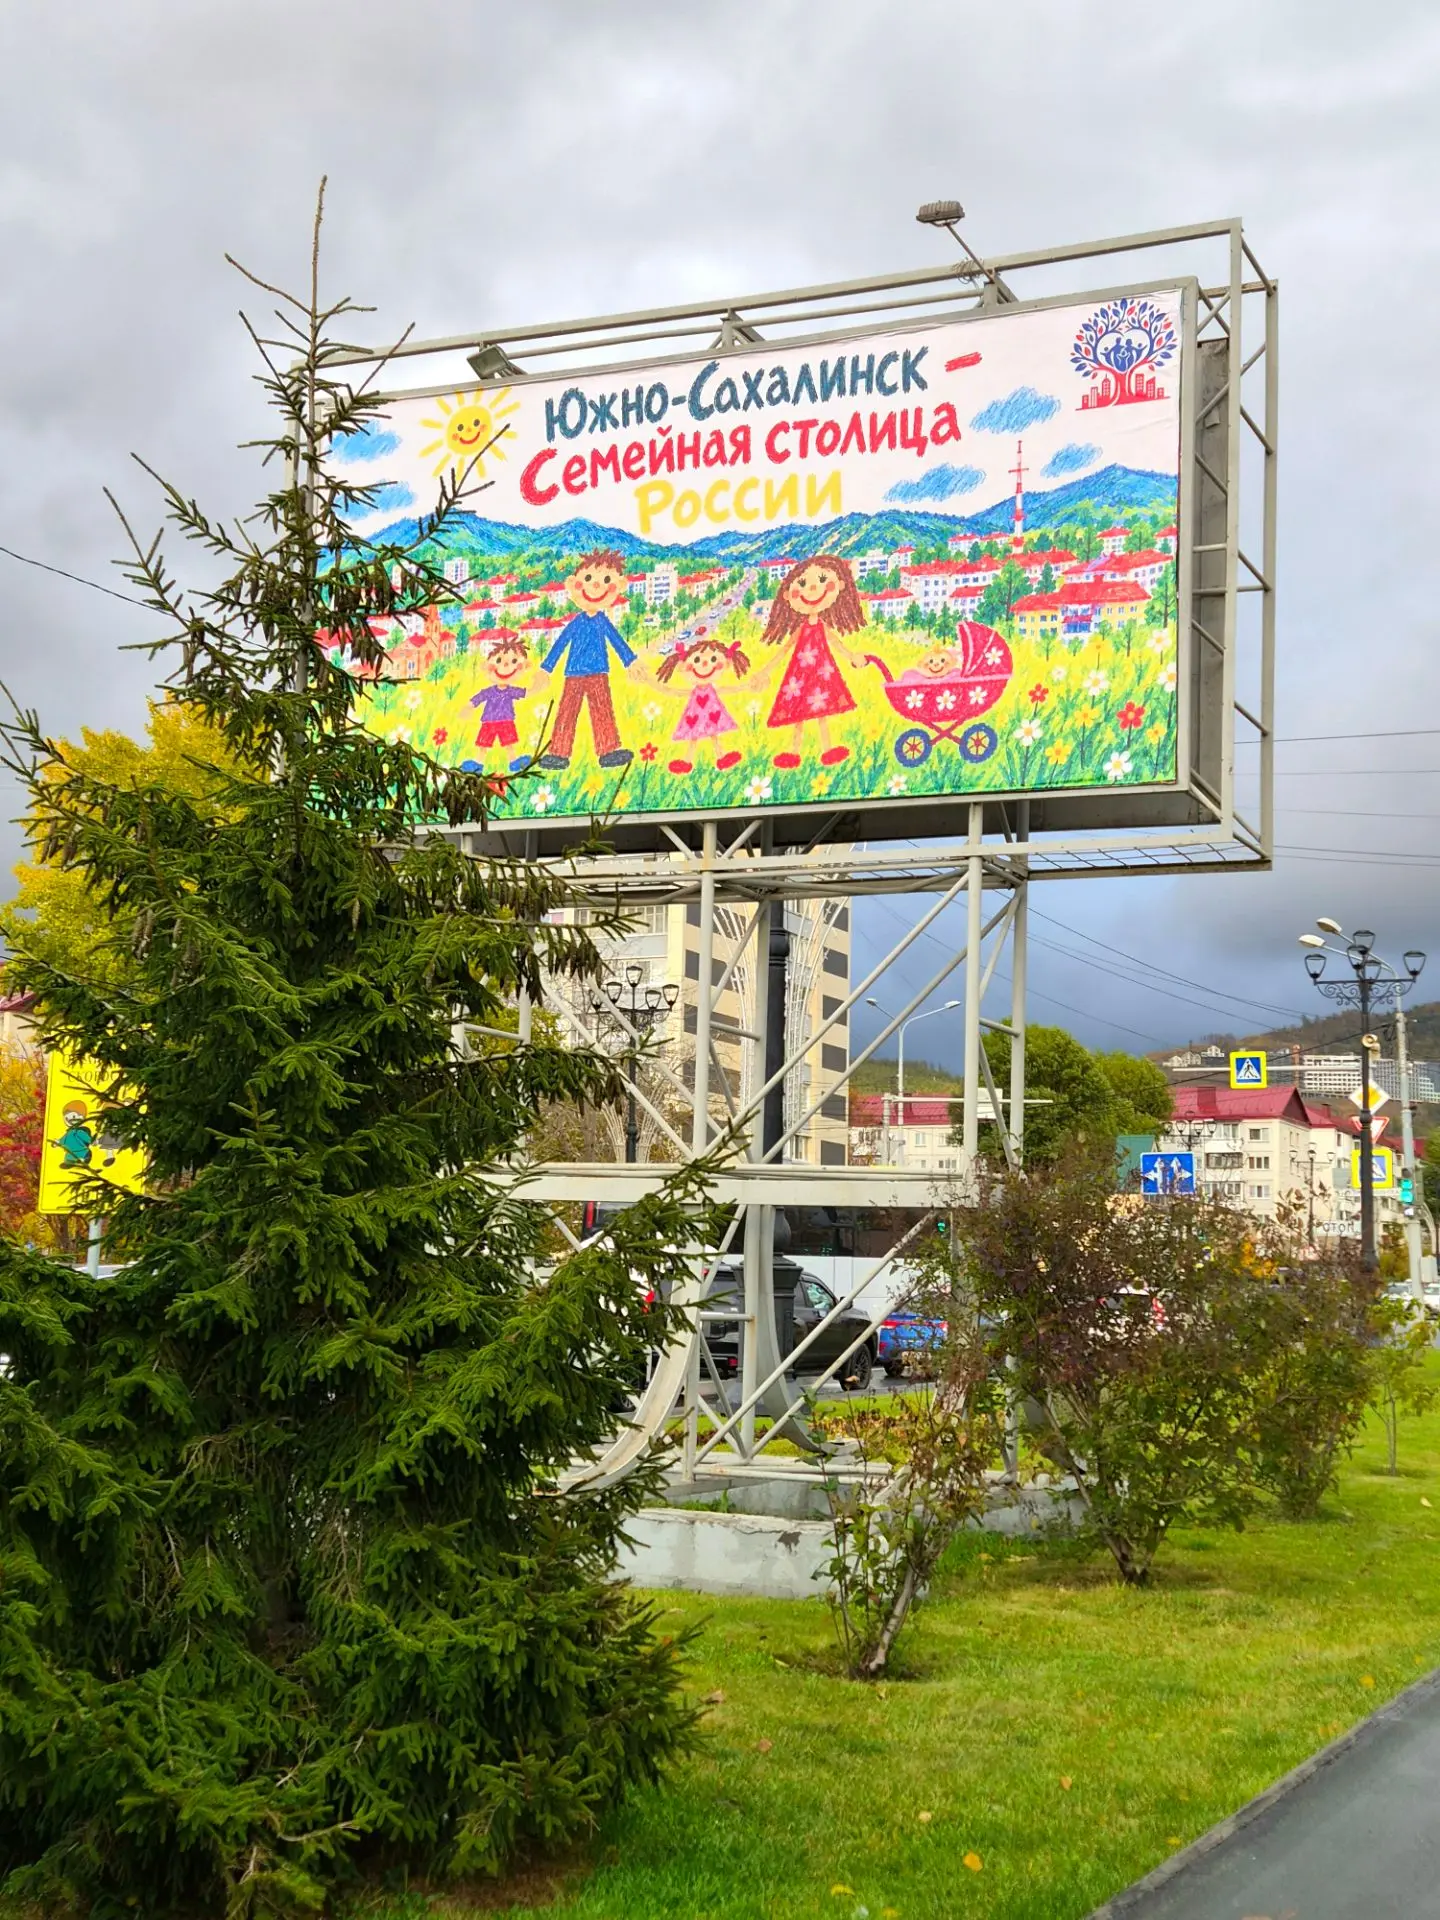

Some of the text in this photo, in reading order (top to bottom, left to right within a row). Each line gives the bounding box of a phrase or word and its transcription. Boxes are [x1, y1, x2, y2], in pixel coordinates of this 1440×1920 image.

[545, 346, 929, 442] Южно-Сахалинск
[519, 401, 962, 506] Семейная столица
[634, 470, 844, 535] России
